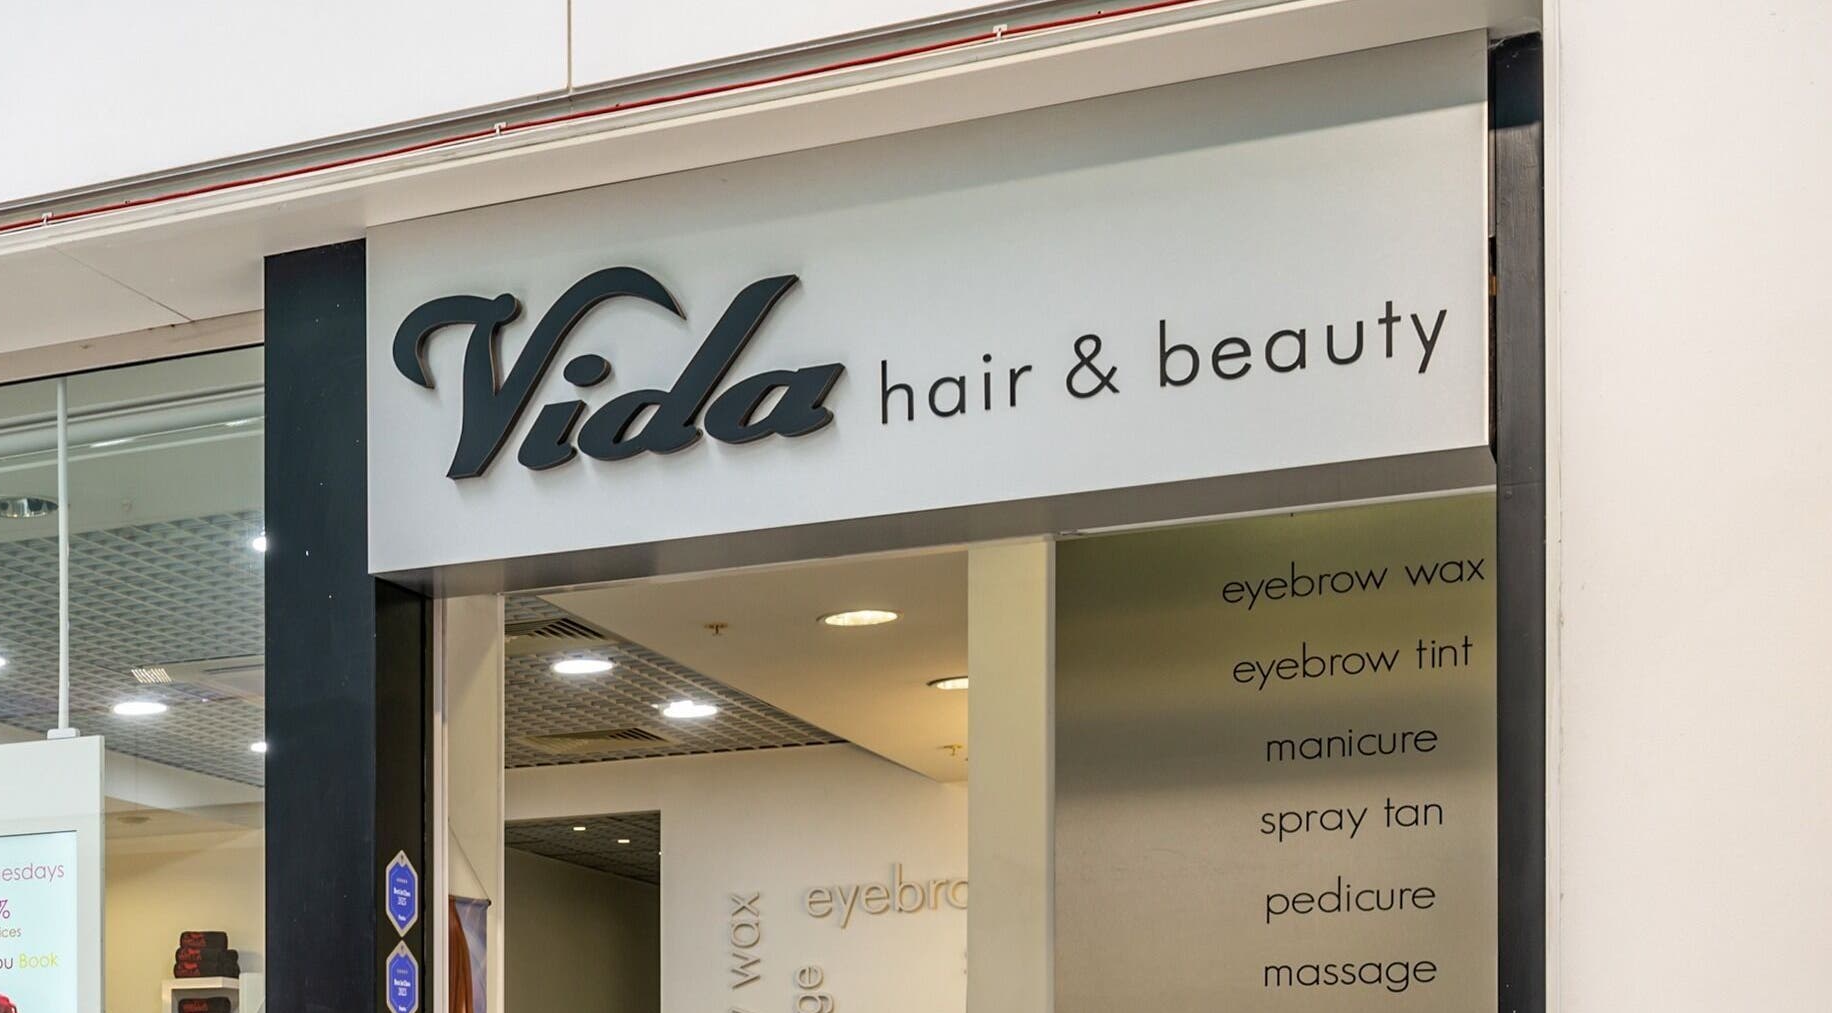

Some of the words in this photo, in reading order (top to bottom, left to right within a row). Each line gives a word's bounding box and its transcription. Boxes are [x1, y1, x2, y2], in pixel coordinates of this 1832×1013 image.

[391, 265, 847, 481] Vida
[879, 353, 1034, 425] hair
[1066, 334, 1120, 399] &
[1158, 300, 1450, 389] beauty
[1221, 562, 1388, 611] eyebrow
[1404, 557, 1486, 587] wax
[1232, 642, 1400, 691] eyebrow
[1416, 636, 1474, 670] tint
[1266, 728, 1439, 763] manicure
[1260, 806, 1369, 842] spray
[1384, 797, 1444, 828] tan
[806, 862, 968, 929] eyebro
[1265, 876, 1437, 924] pedicure
[19, 952, 58, 968] Book
[729, 890, 762, 991] wax
[1264, 958, 1438, 993] massage
